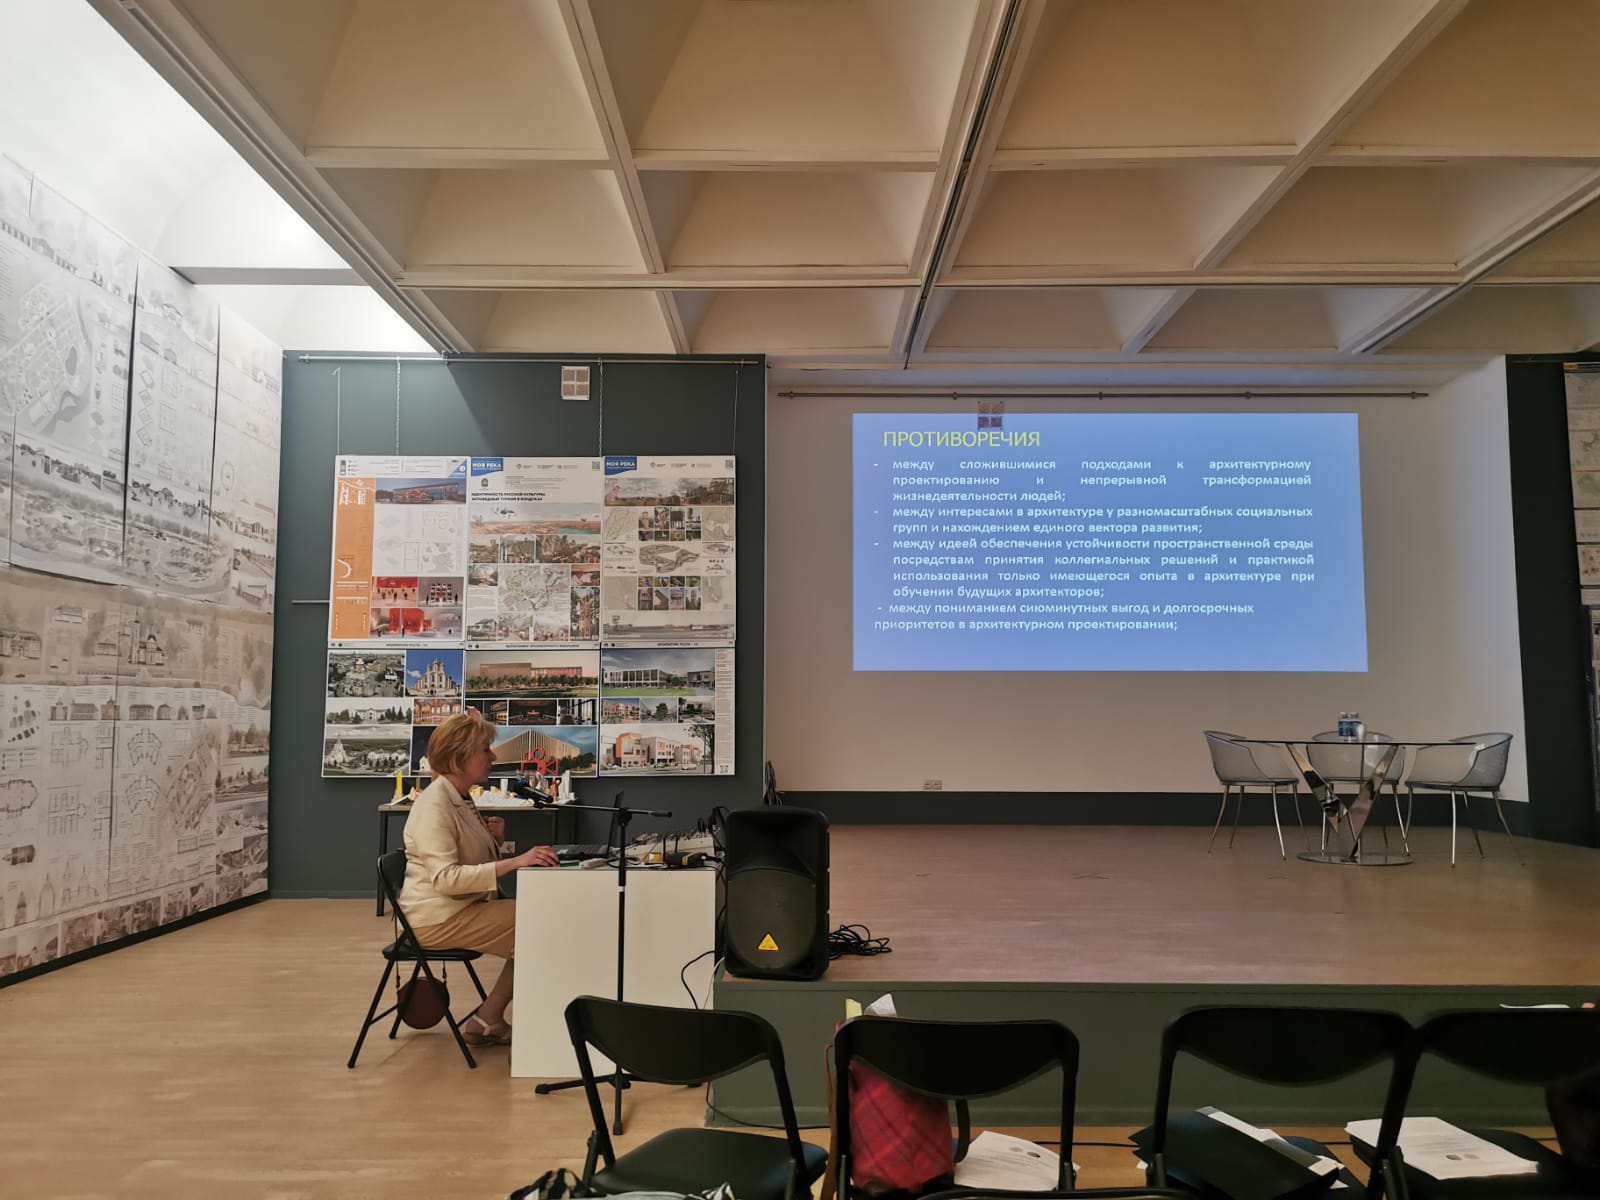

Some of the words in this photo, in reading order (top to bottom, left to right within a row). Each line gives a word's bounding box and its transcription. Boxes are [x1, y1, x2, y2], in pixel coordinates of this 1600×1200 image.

[883, 431, 1041, 448] ПРОТИВОРЕЧИЯ
[892, 461, 935, 472] между
[959, 460, 1056, 470] сложившимися
[1081, 460, 1152, 471] подходами
[1176, 461, 1184, 470] к
[1208, 460, 1312, 472] архитектурному
[892, 476, 1000, 488] проектированию
[1036, 476, 1044, 485] и
[1080, 474, 1167, 487] непрерывной
[1202, 474, 1312, 488] трансформацией
[892, 492, 1018, 503] жизнедеятельности
[1019, 489, 1066, 503] людей;
[892, 508, 935, 519] между
[938, 508, 1014, 519] интересами
[1016, 508, 1024, 517] в
[1026, 508, 1104, 519] архитектуре
[1106, 508, 1114, 519] у
[1116, 505, 1234, 519] разномасштабных
[1236, 508, 1313, 519] социальных
[892, 524, 928, 535] групп
[931, 524, 939, 533] и
[942, 524, 1031, 534] нахождением
[1032, 523, 1085, 535] единого
[1088, 524, 1138, 535] вектора
[1141, 524, 1203, 535] развития;
[892, 540, 936, 551] между
[938, 537, 978, 551] идеей
[980, 537, 1063, 549] обеспечения
[1065, 537, 1150, 551] устойчивости
[1153, 537, 1271, 551] пространственной
[1273, 540, 1314, 551] среды
[893, 556, 975, 567] посредствам
[984, 556, 1044, 567] принятия
[1054, 556, 1151, 565] коллегиальных
[1160, 553, 1219, 567] решений
[1228, 556, 1238, 565] и
[1247, 553, 1315, 567] практикой
[893, 572, 989, 581] использования
[997, 572, 1041, 581] только
[1049, 572, 1130, 583] имеющегося
[1139, 572, 1178, 581] опыта
[1187, 572, 1195, 581] в
[1203, 572, 1282, 583] архитектуре
[1291, 572, 1315, 584] при
[892, 585, 954, 599] обучении
[957, 585, 1012, 599] будущих
[1015, 588, 1105, 599] архитекторов;
[888, 604, 932, 615] между
[934, 604, 1017, 613] пониманием
[1019, 604, 1108, 615] сиюминутных
[1111, 604, 1150, 615] выгод
[1152, 604, 1161, 614] и
[1162, 604, 1255, 616] долгосрочных
[874, 621, 955, 632] приоритетов
[958, 621, 966, 630] в
[969, 621, 1065, 632] архитектурном
[1067, 621, 1178, 632] проектировании;
